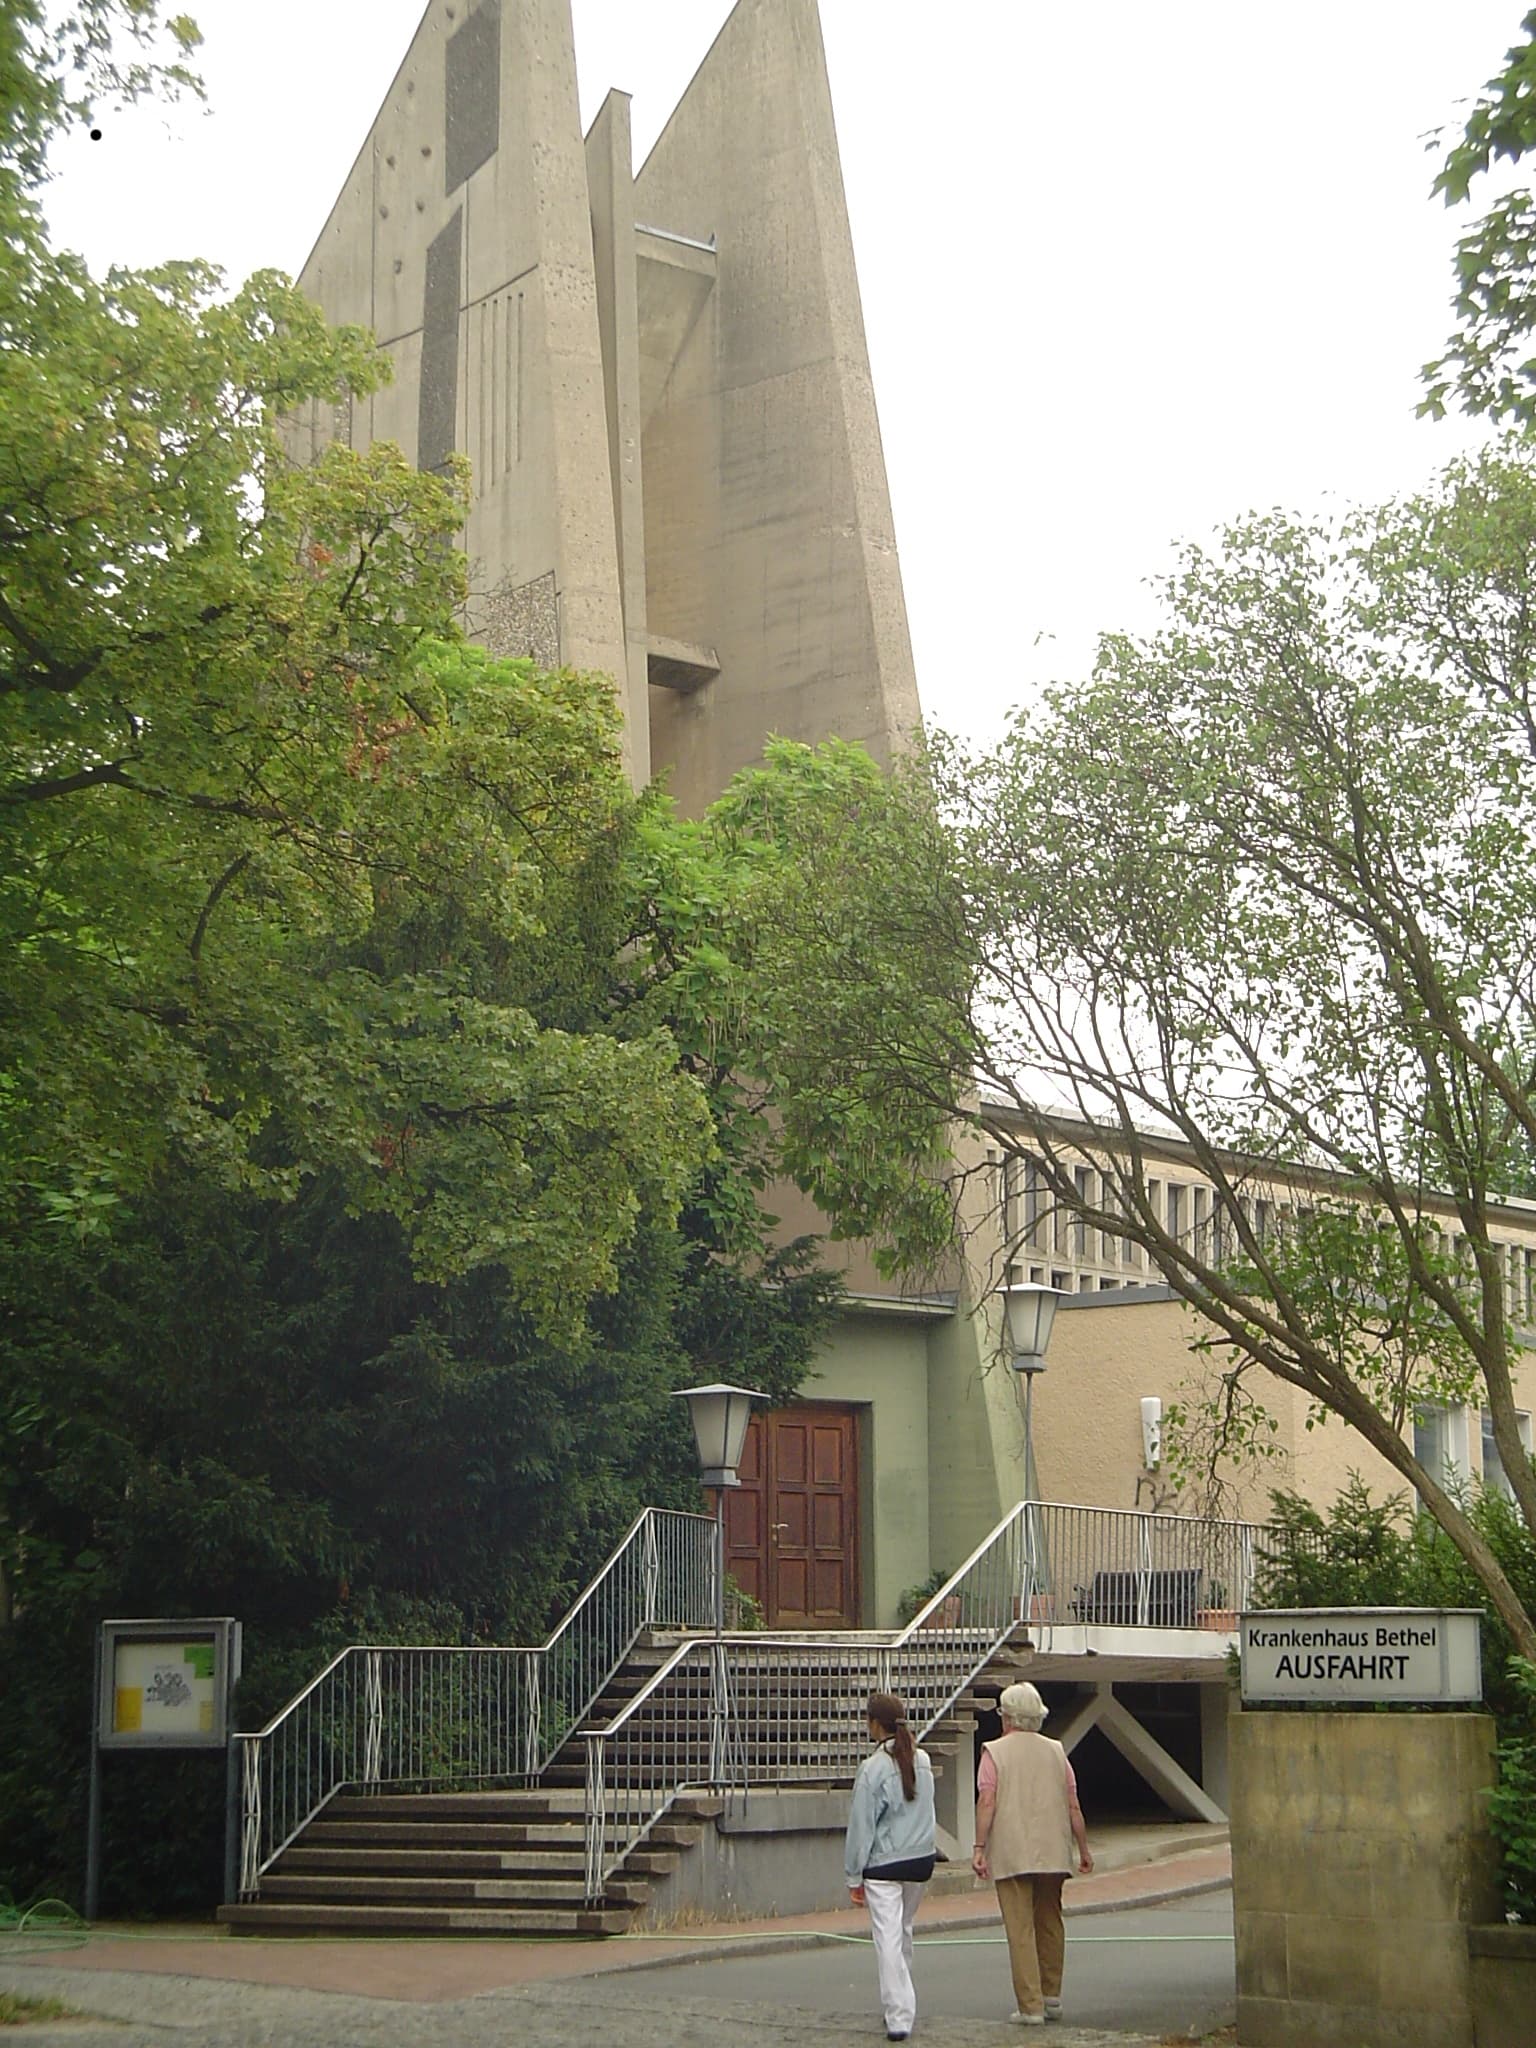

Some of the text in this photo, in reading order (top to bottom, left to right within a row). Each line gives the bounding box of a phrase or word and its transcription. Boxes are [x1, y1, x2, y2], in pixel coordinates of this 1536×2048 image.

[1249, 1628, 1436, 1647] Krankenhaus Bethel
[1275, 1655, 1410, 1680] AUSFAHRT
